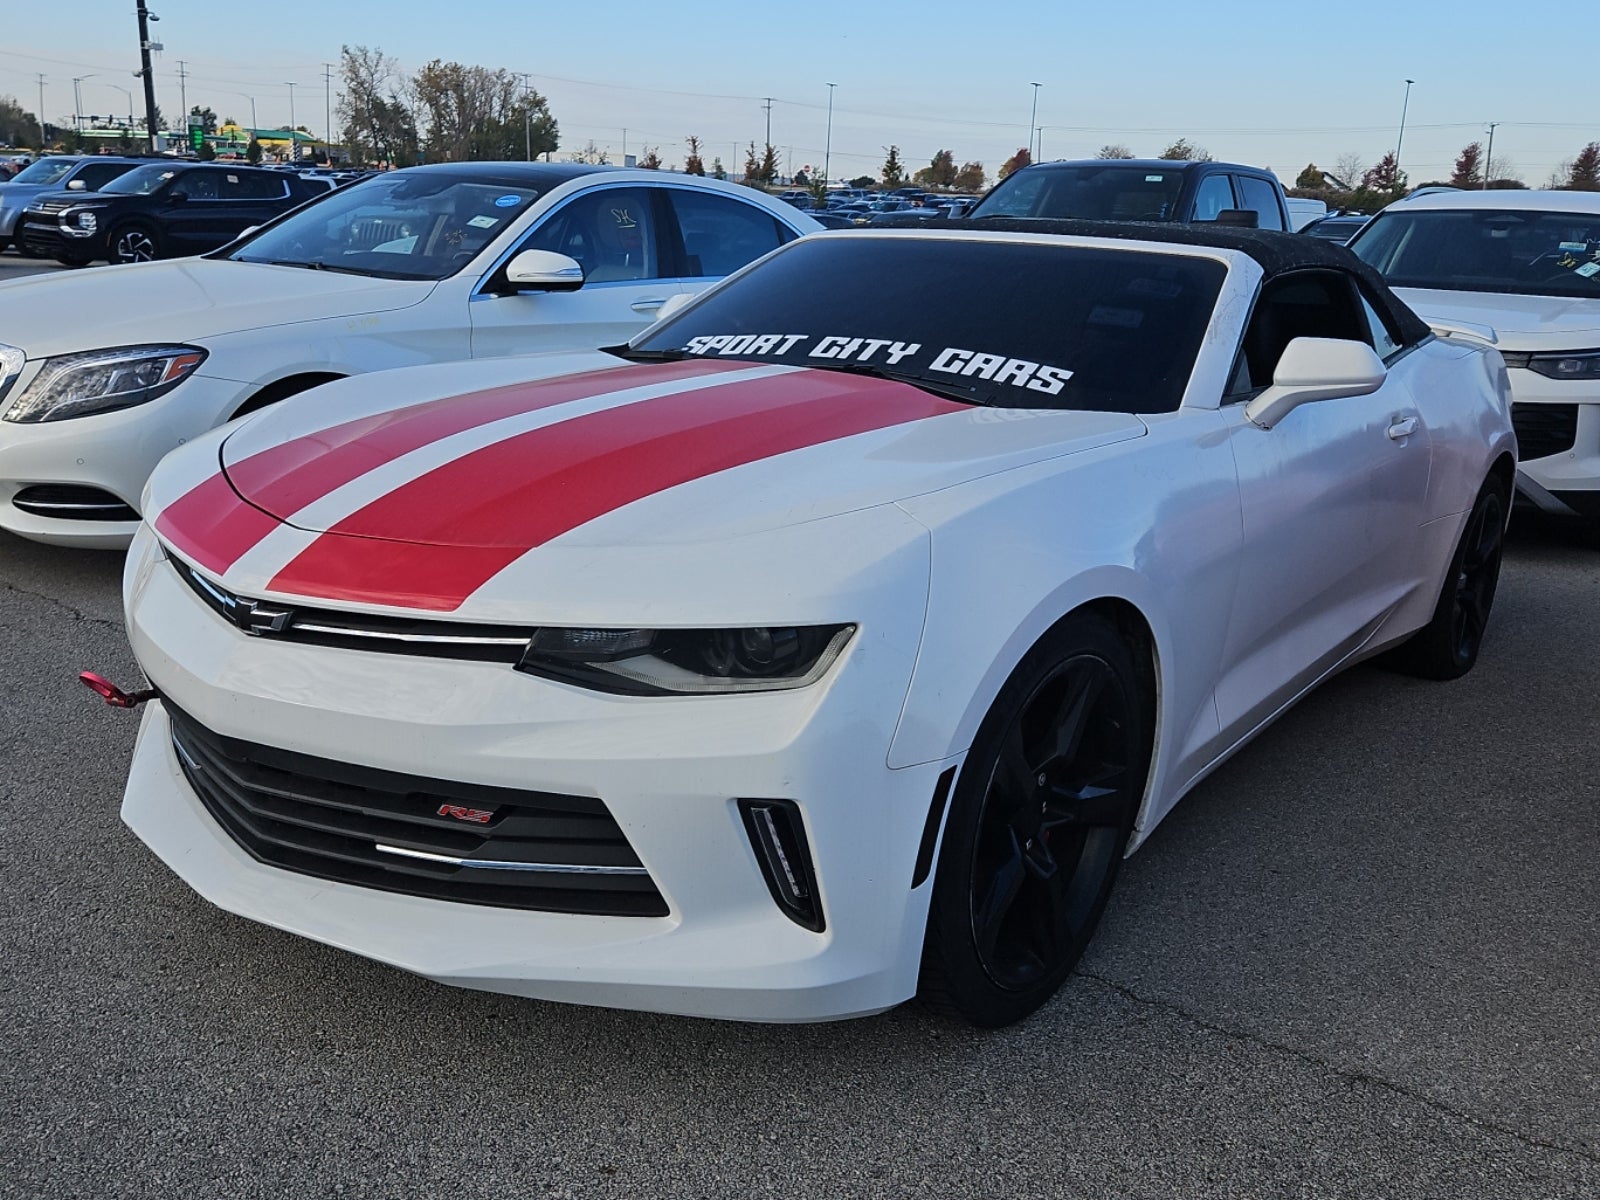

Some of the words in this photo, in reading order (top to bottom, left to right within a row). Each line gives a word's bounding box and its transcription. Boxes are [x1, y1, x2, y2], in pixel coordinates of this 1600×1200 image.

[682, 334, 809, 355] SPORT
[809, 336, 922, 365] CITY
[929, 347, 1074, 395] CARS
[437, 804, 494, 823] RS
